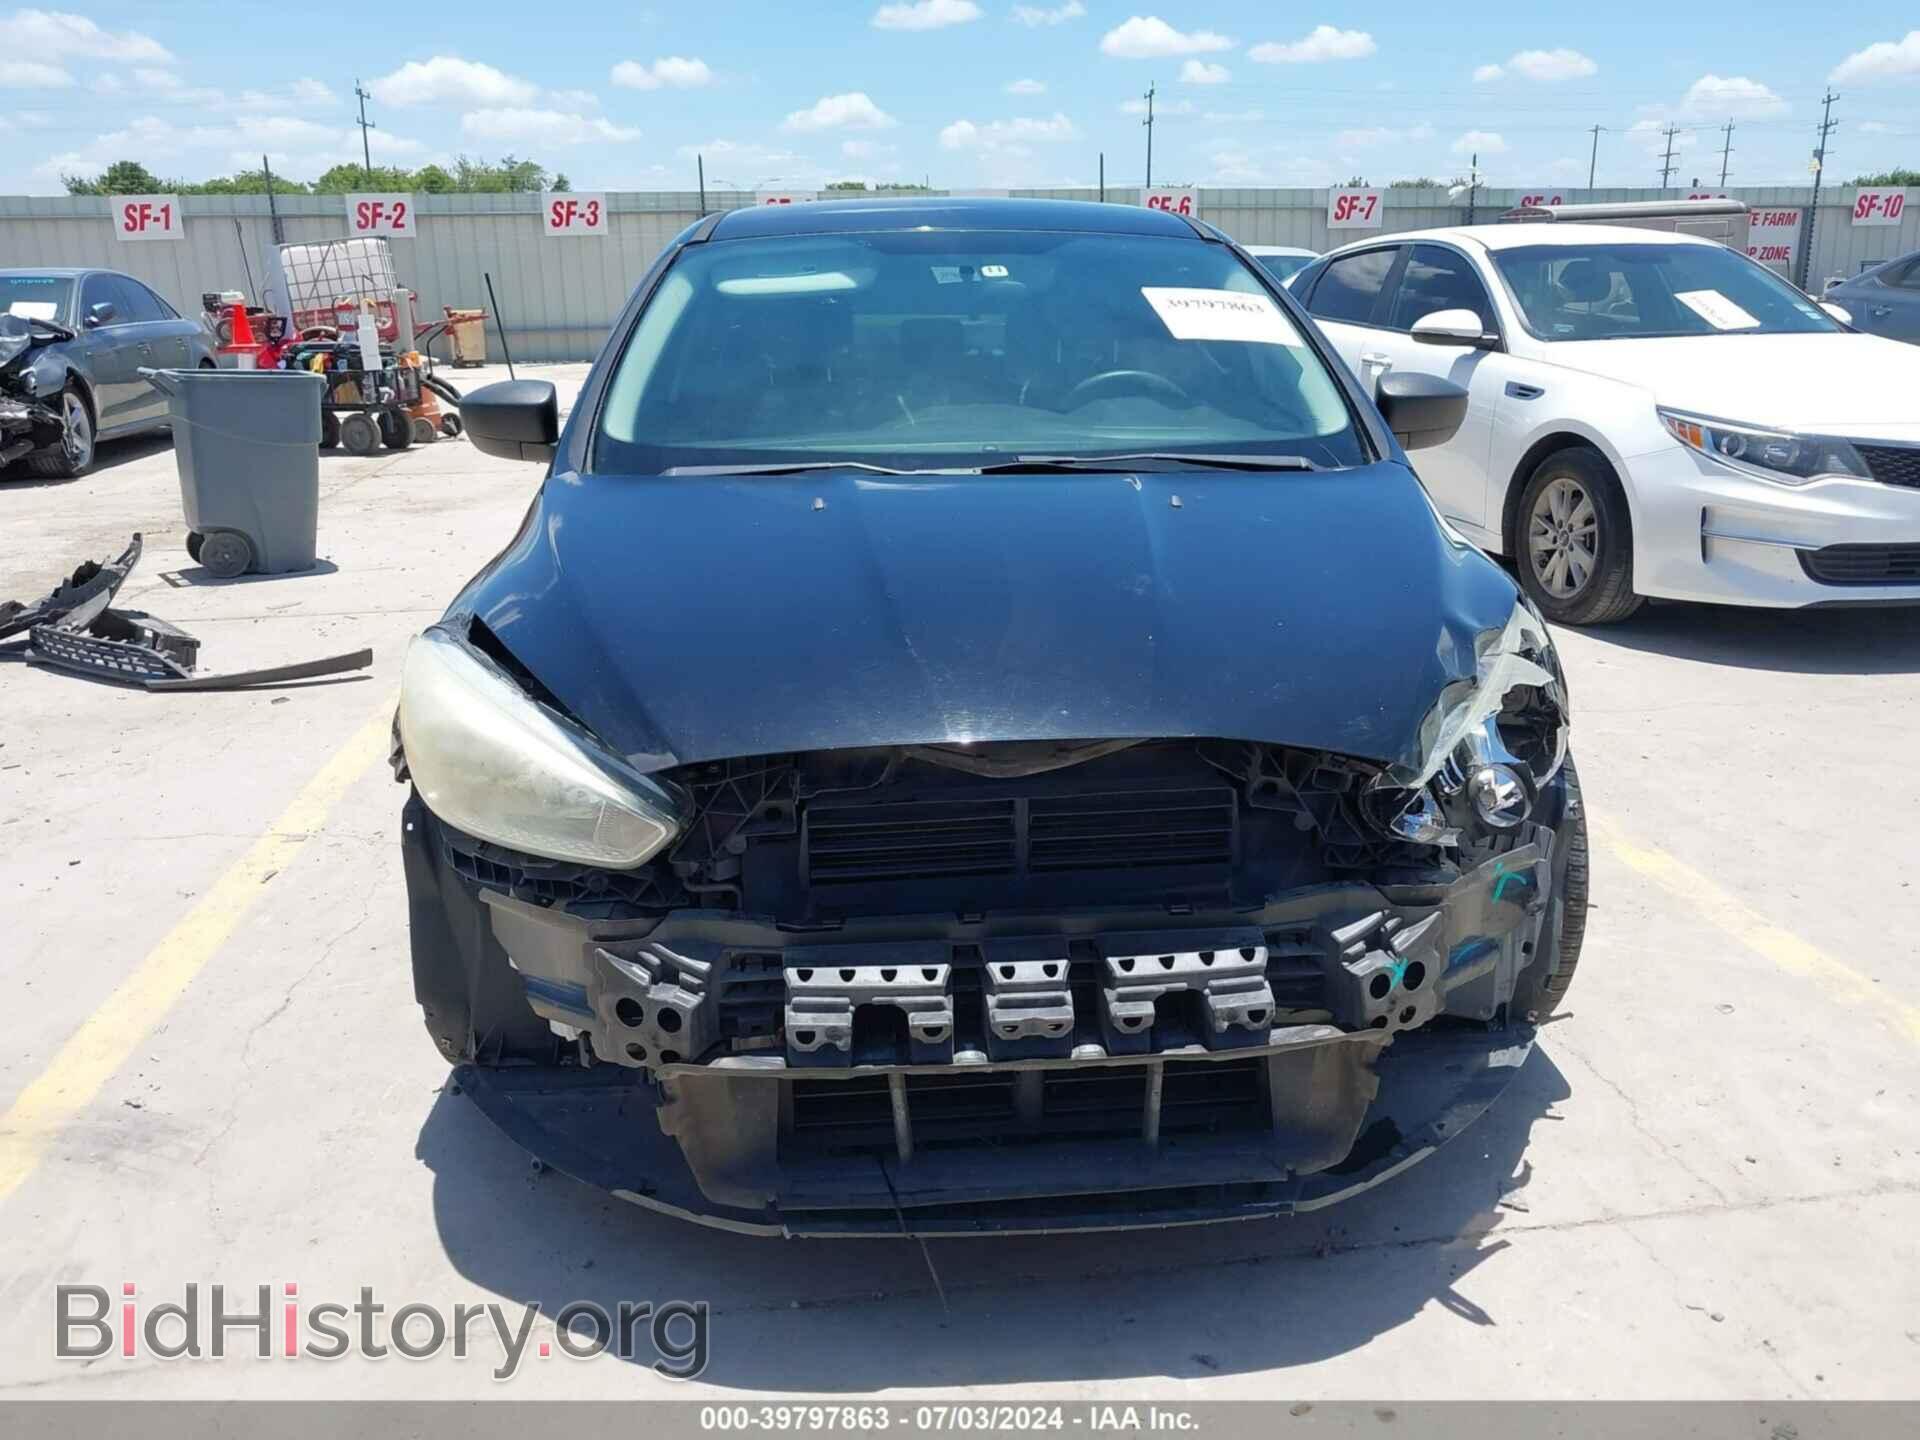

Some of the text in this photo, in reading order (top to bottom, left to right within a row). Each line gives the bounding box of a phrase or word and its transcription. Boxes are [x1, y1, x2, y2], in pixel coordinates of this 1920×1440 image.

[124, 203, 170, 232] SF-1
[356, 202, 405, 229] SF-2
[551, 200, 599, 228] SF-3
[1334, 195, 1377, 220] SF-7
[1761, 211, 1798, 226] FARM
[1855, 194, 1904, 218] SF-10
[1758, 246, 1792, 261] ZONE
